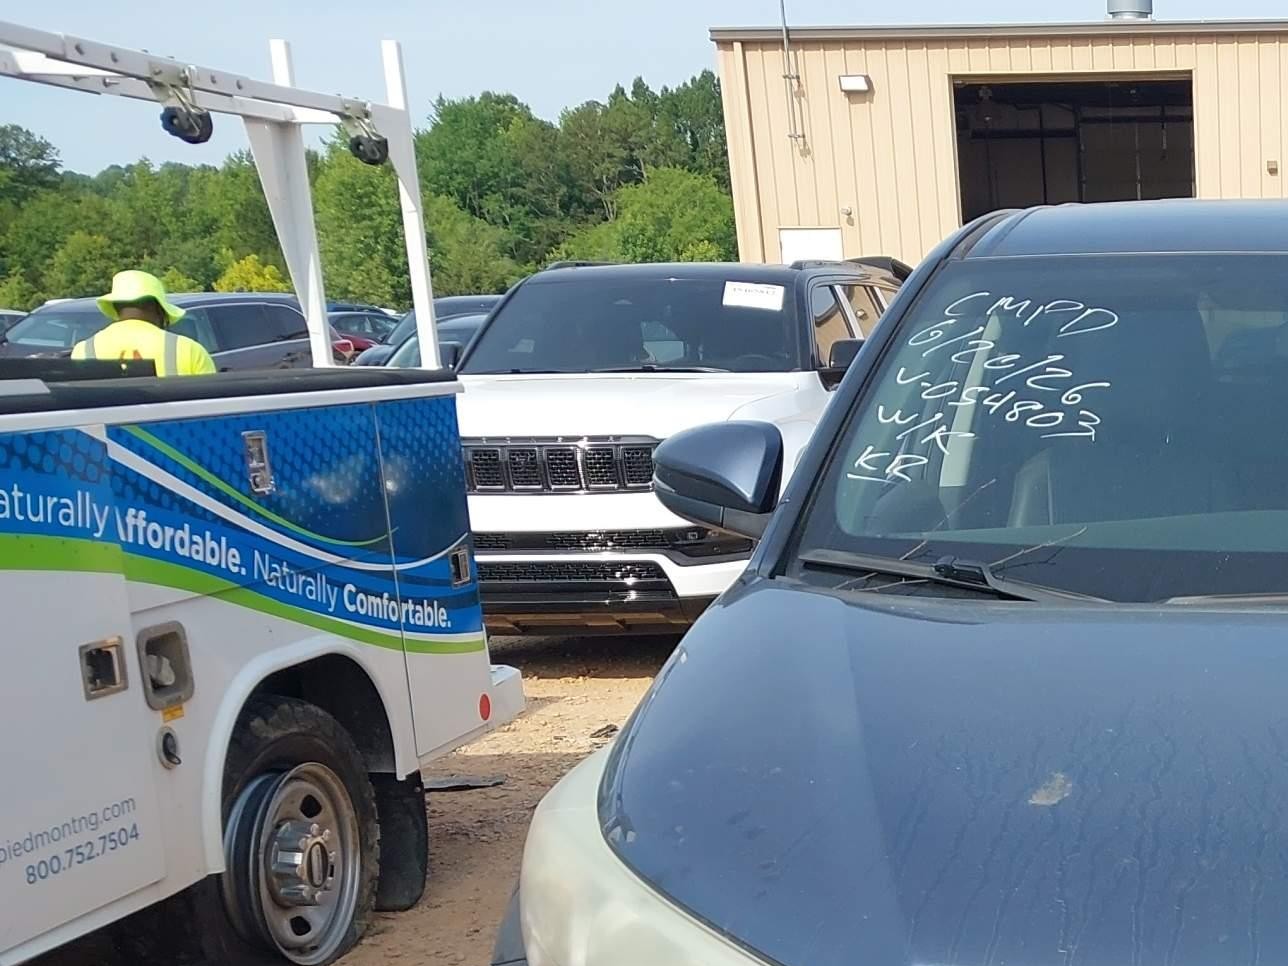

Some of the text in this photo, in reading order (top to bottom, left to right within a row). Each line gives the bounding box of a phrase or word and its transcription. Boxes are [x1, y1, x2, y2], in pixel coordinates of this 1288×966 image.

[945, 292, 1119, 337] CMPD
[253, 549, 339, 612] Naturally
[343, 583, 452, 628] Comfortable.
[25, 822, 140, 885] 800.752.7504
